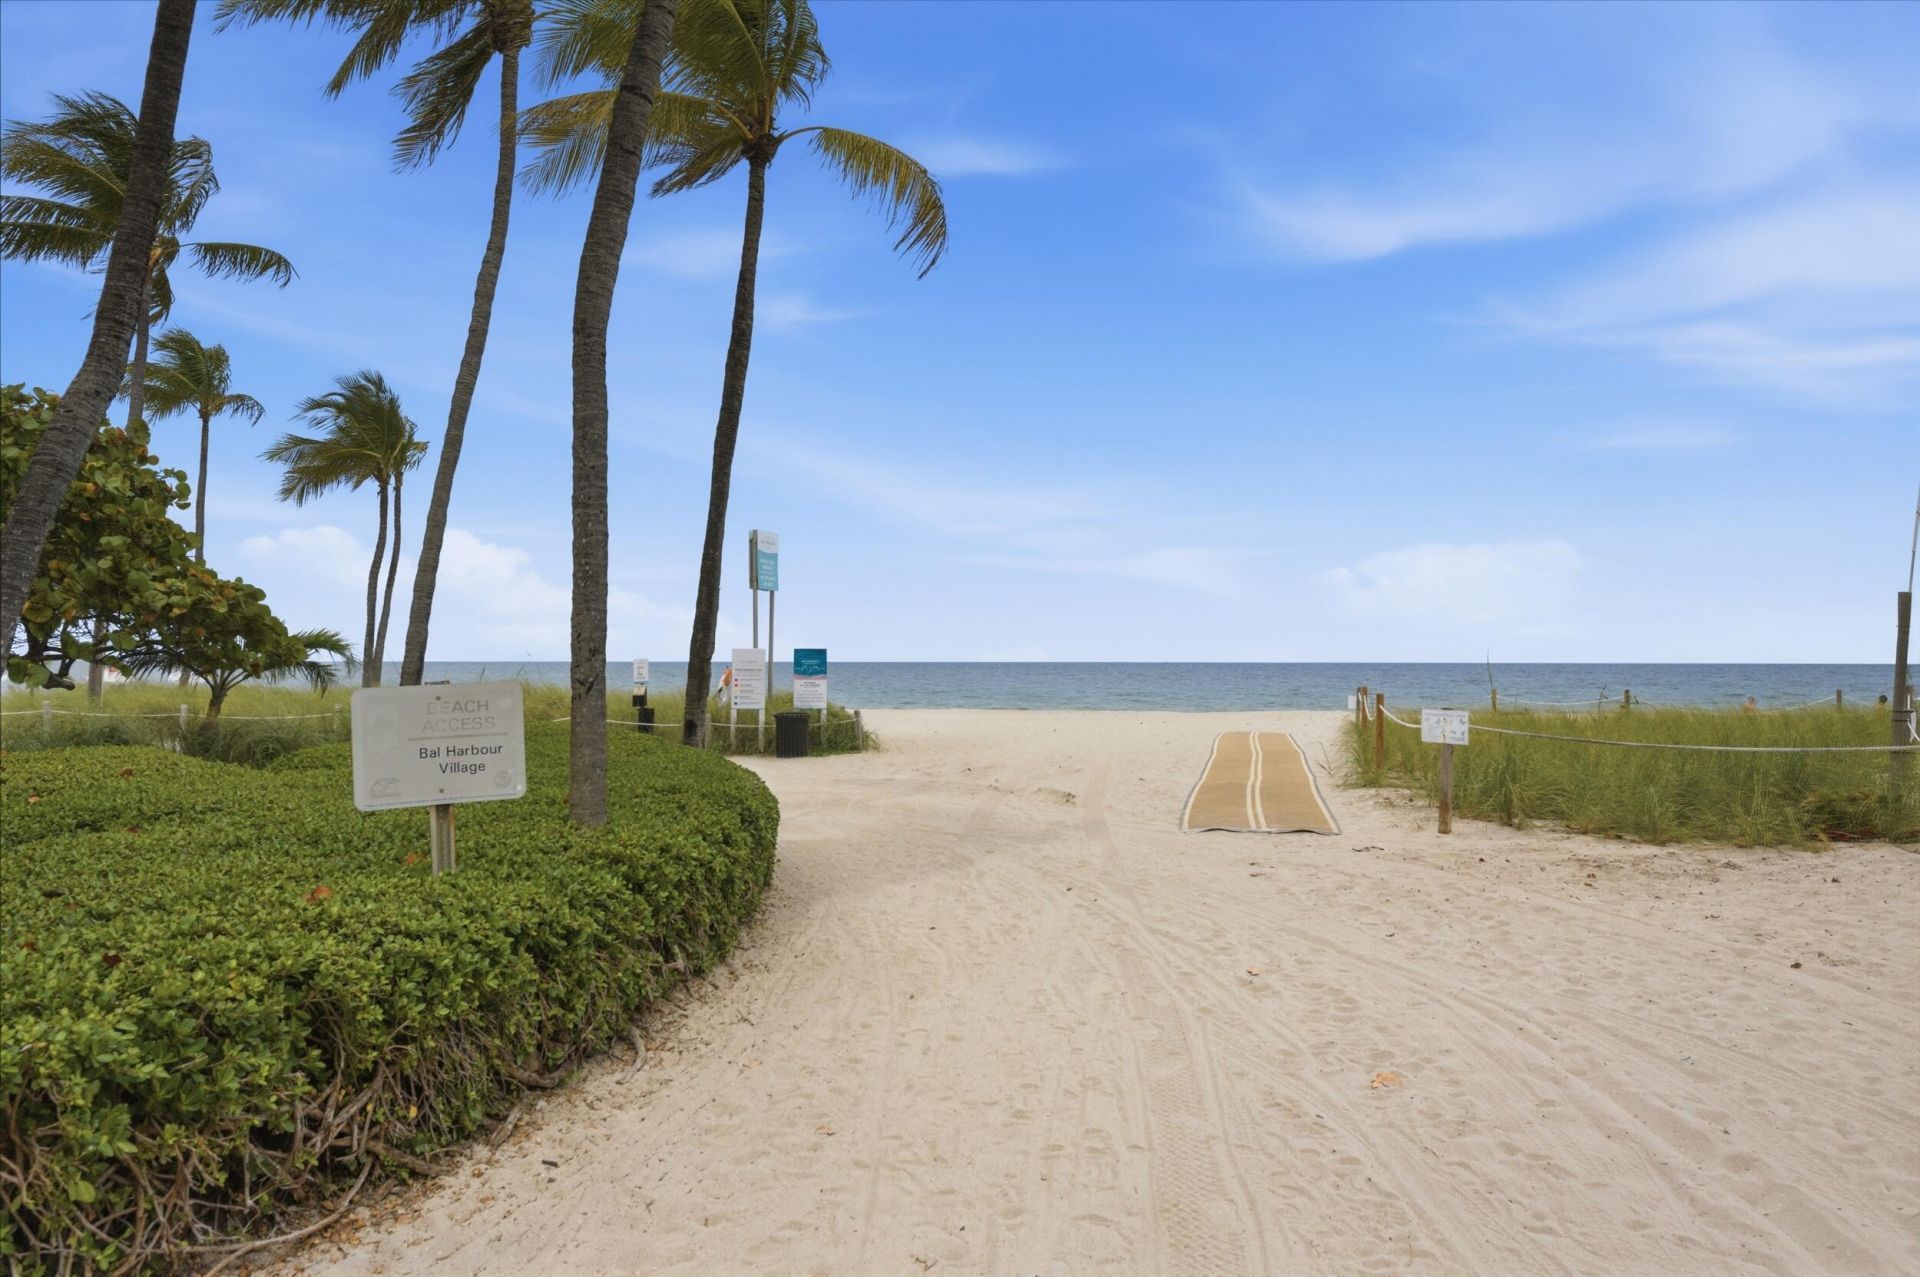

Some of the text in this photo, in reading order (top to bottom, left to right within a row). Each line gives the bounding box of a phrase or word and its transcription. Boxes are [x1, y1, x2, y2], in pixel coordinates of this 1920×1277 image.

[422, 716, 496, 733] ACCESS
[419, 744, 503, 759] Bal Harbour
[439, 761, 486, 775] Village
